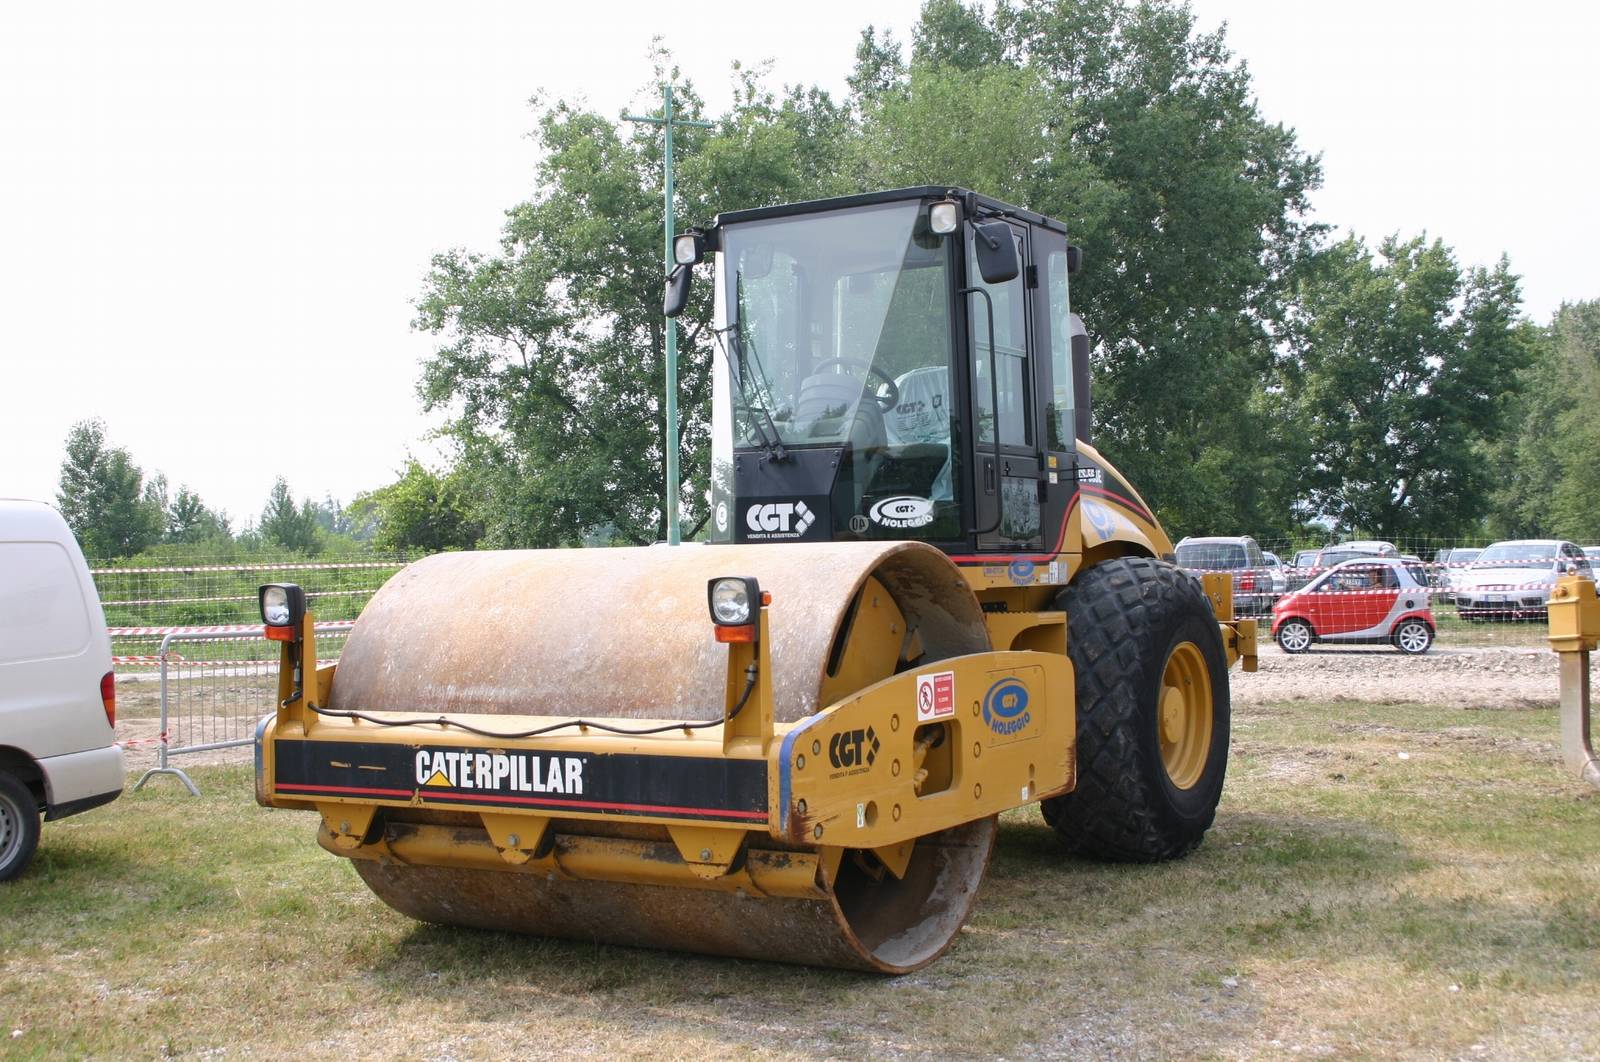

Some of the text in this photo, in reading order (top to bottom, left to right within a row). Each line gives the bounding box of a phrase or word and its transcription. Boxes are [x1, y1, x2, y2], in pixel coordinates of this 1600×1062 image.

[746, 503, 794, 532] CGT
[881, 514, 934, 529] NOLEGGIO
[895, 505, 909, 513] CGT
[991, 711, 1031, 735] NOLEGGIO
[828, 728, 865, 769] CGT
[415, 750, 583, 795] CATERPILLAR
